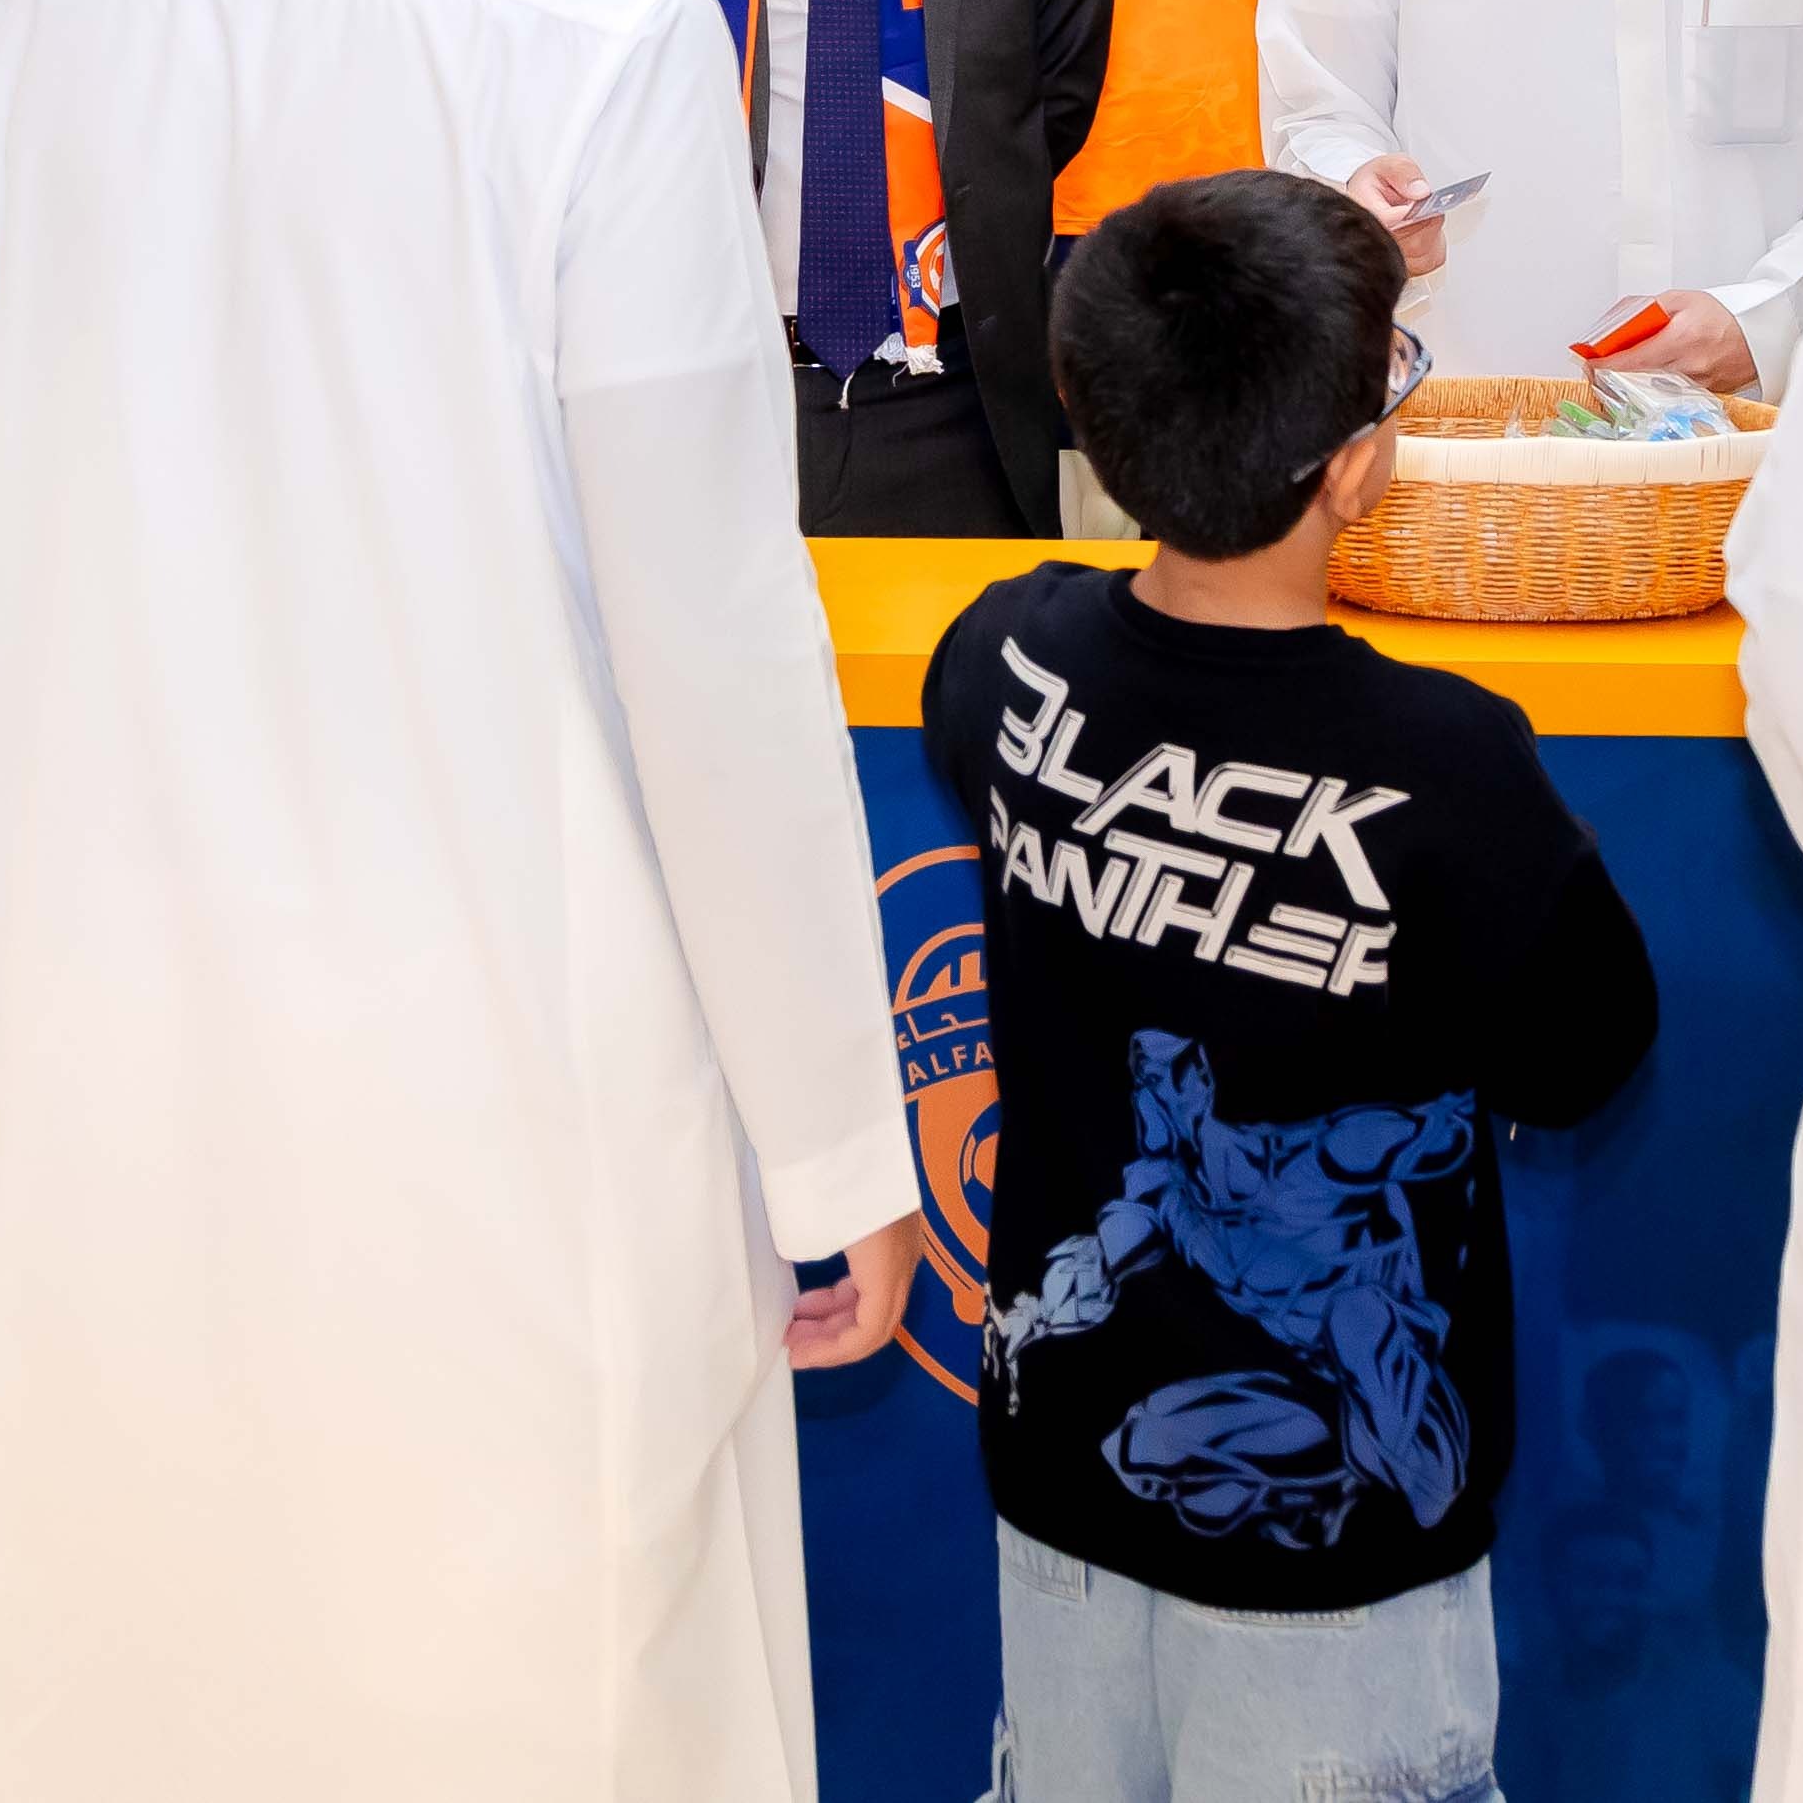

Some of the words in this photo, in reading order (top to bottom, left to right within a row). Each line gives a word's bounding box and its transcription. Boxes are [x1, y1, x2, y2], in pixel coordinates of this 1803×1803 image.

[909, 264, 921, 288] 1953
[996, 635, 1410, 911] BLACK
[906, 1041, 995, 1087] ALFA
